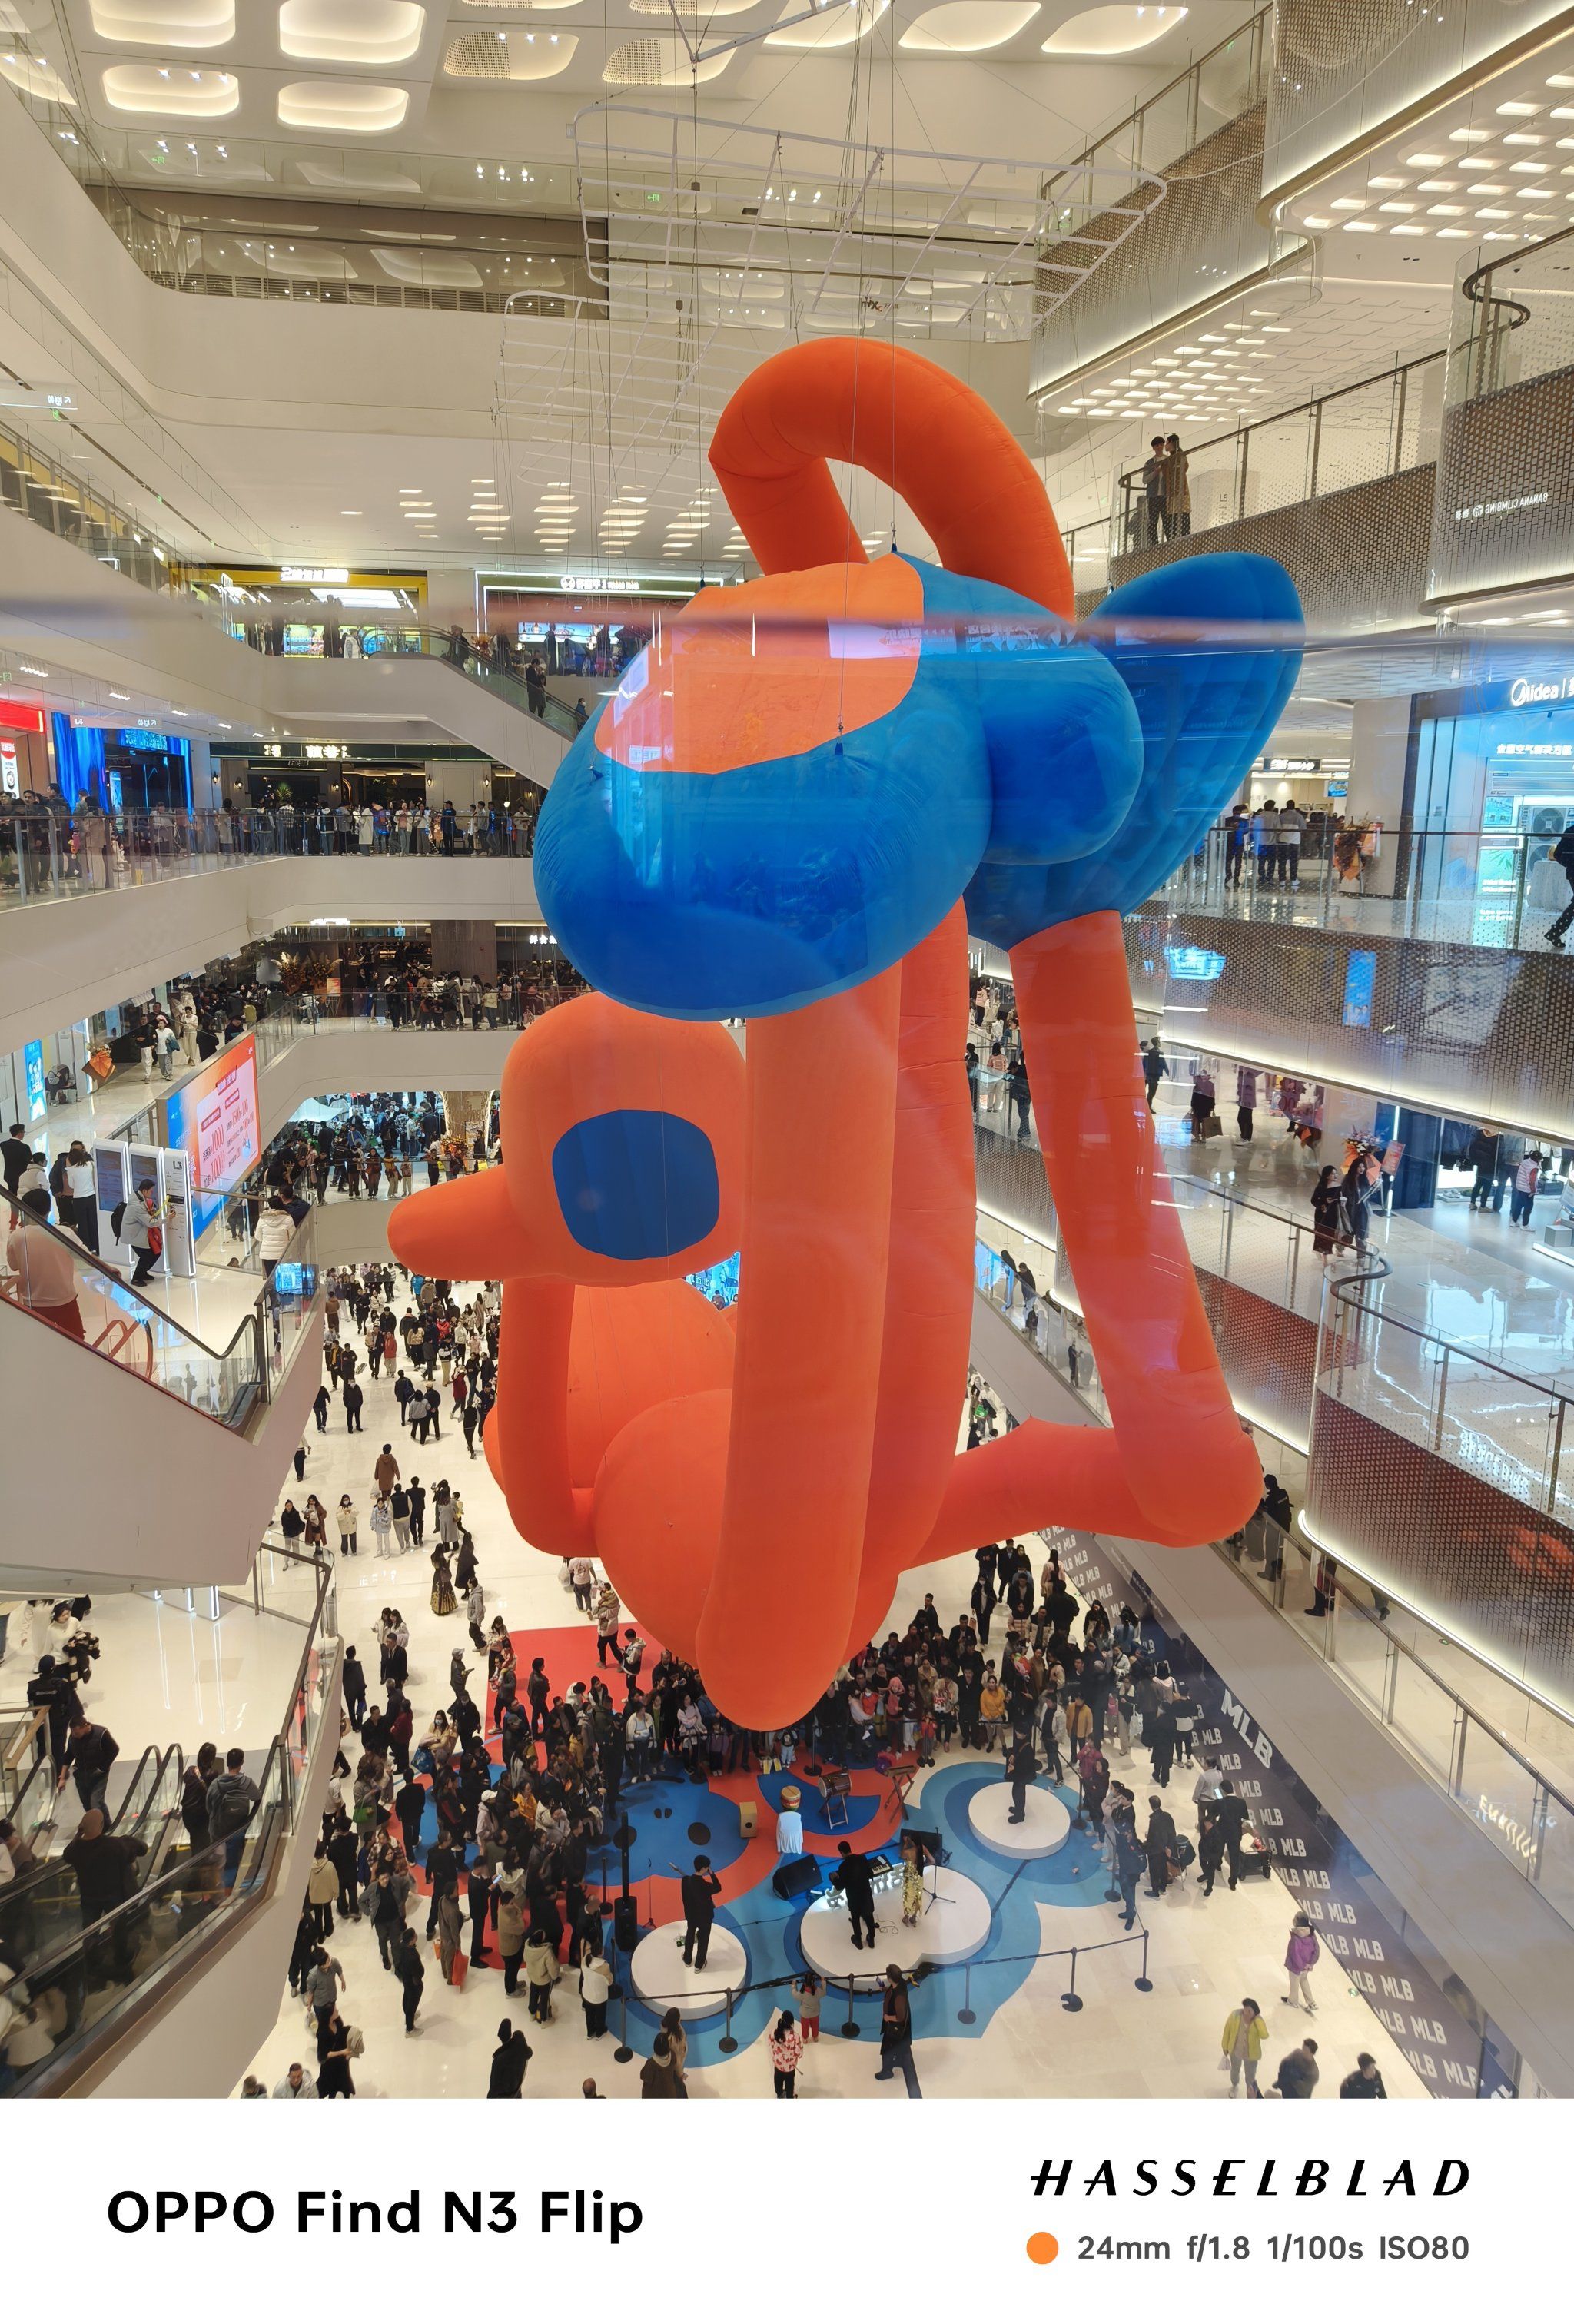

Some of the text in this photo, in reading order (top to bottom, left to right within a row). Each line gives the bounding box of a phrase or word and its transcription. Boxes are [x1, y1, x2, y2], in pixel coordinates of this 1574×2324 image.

[1511, 678, 1559, 707] Midea
[172, 1160, 183, 1170] L3
[1063, 1534, 1076, 1552] MLB
[1074, 1550, 1088, 1567] MLB
[1085, 1566, 1101, 1584] MLB
[1097, 1583, 1113, 1602] MLB
[1201, 1728, 1223, 1745] MLB
[1220, 1688, 1273, 1768] MLB
[1220, 1753, 1242, 1771] MLB
[1239, 1780, 1263, 1798] MLB
[1259, 1808, 1284, 1826] MLB
[1280, 1838, 1307, 1857] MLB
[1303, 1869, 1331, 1890] MLB
[1327, 1902, 1356, 1924] MLB
[1353, 1937, 1385, 1961] MLB
[1380, 1974, 1415, 2002] MLB
[1410, 2015, 1447, 2045] MLB
